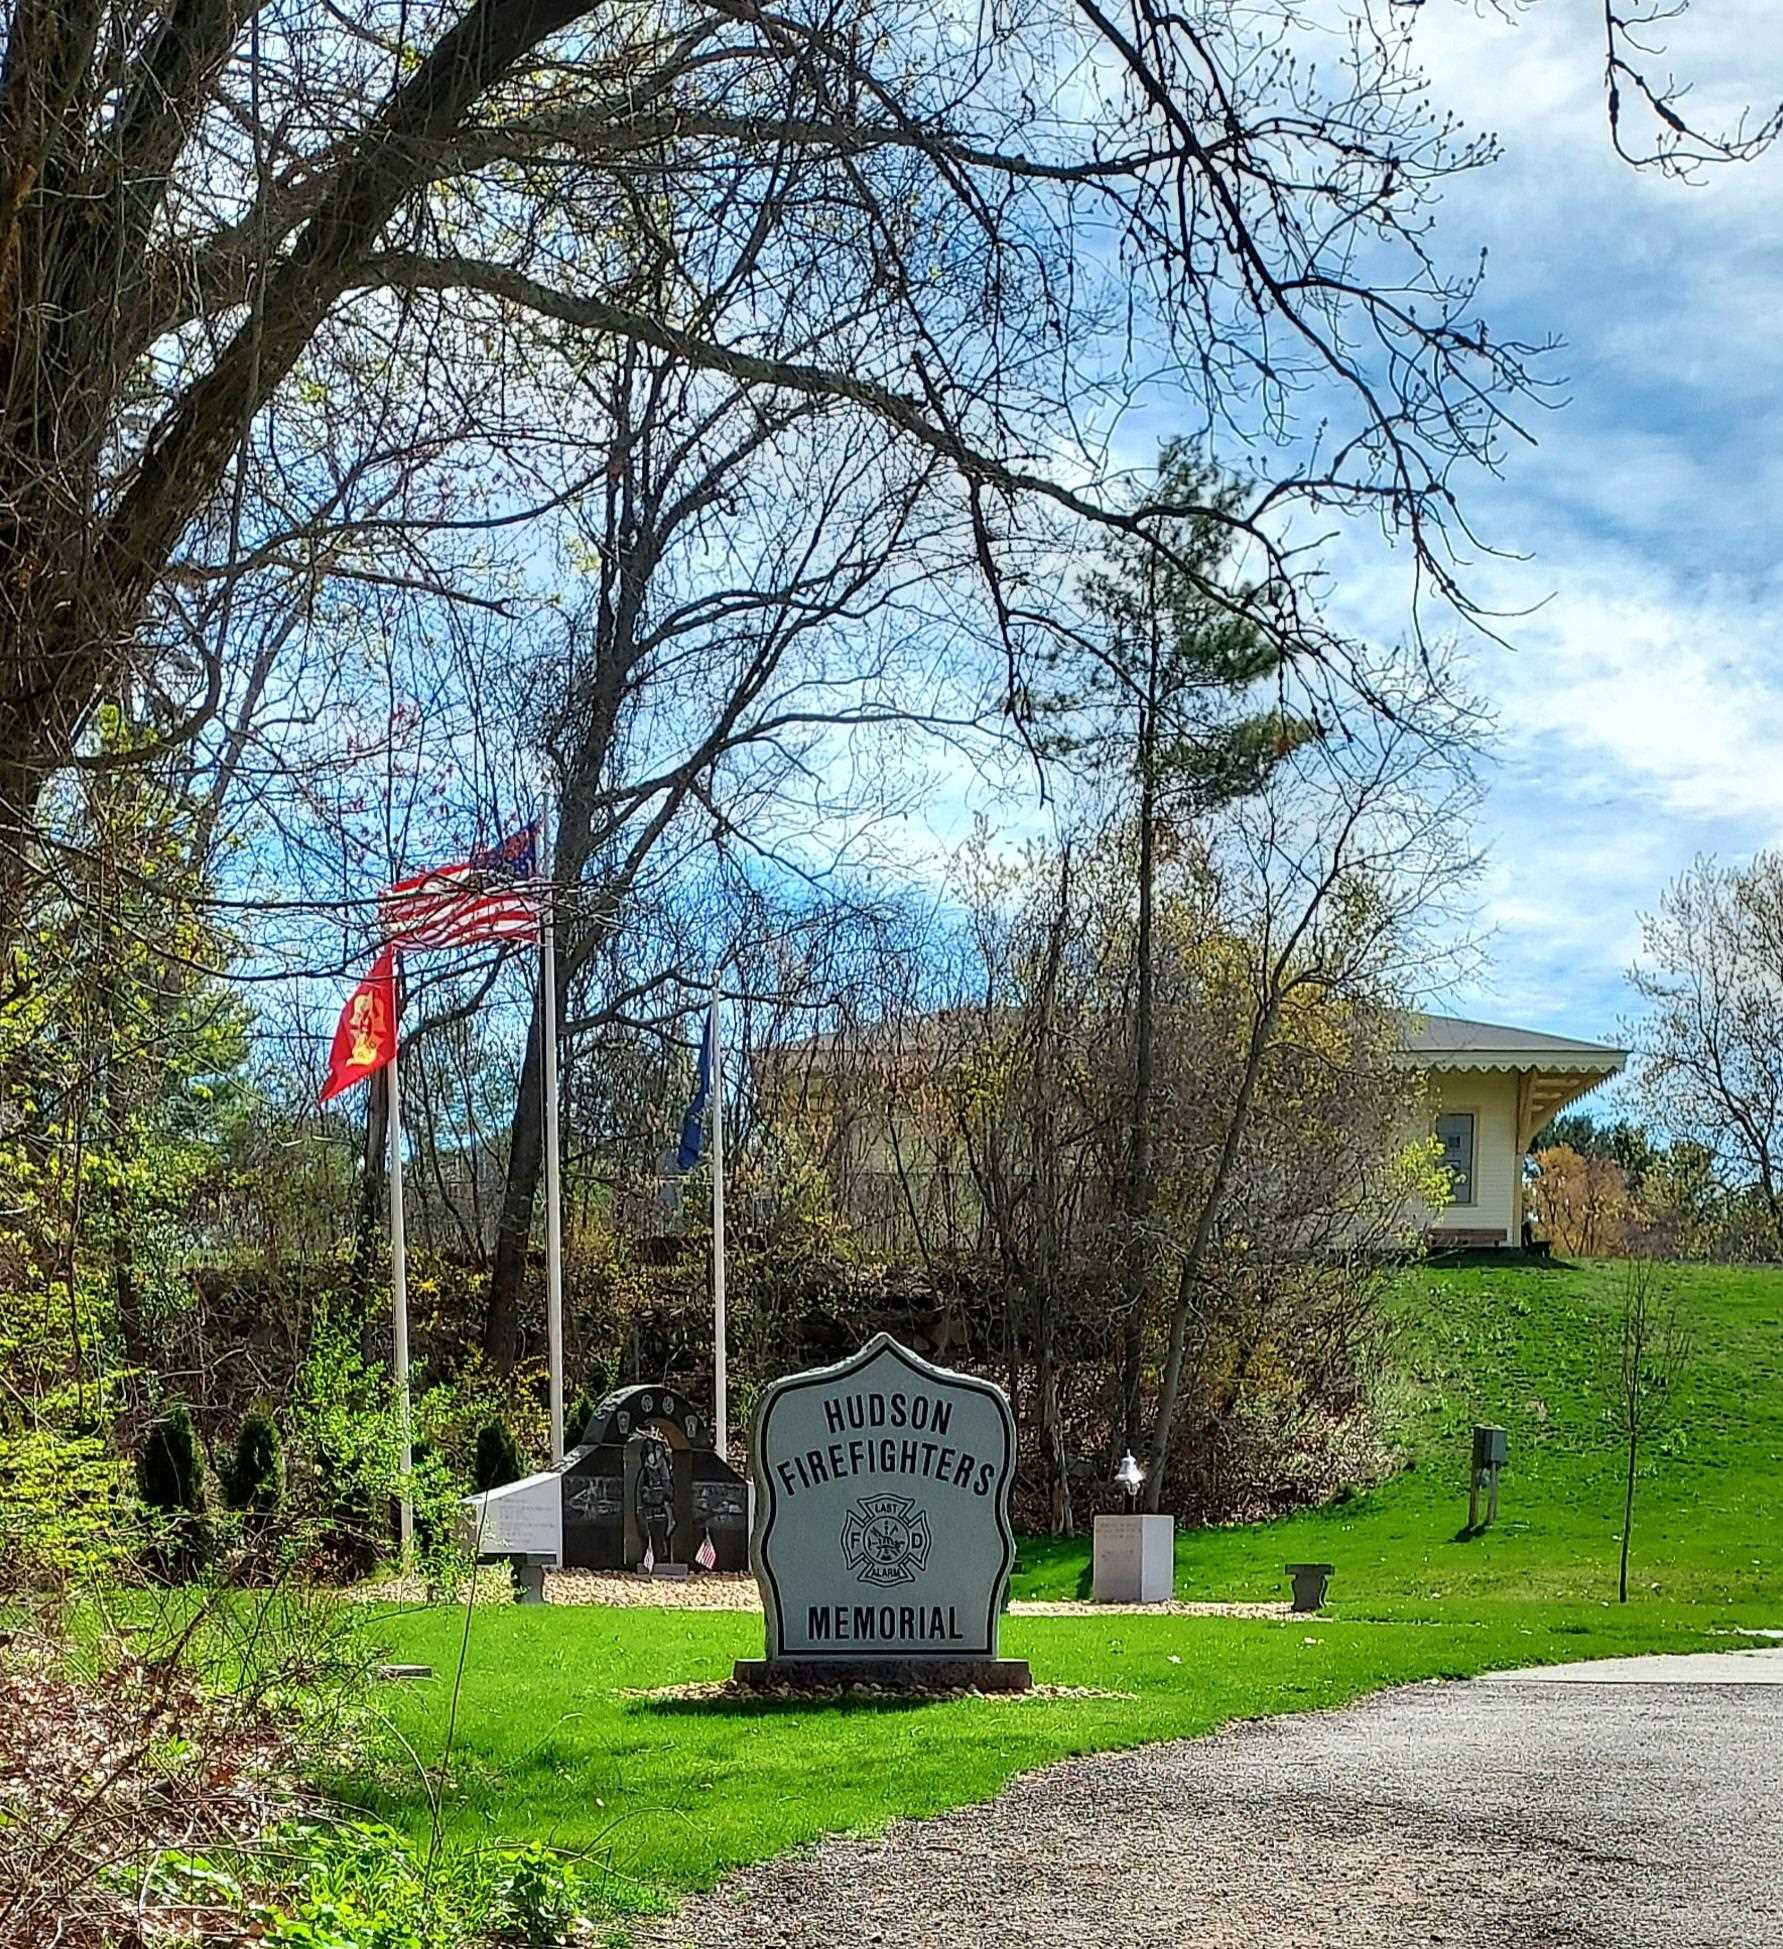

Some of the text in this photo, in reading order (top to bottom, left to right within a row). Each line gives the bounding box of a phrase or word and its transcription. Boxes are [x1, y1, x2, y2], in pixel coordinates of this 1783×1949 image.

[823, 1393, 953, 1435] HUDSON
[776, 1439, 996, 1497] FIREFIGHTERS
[874, 1503, 898, 1513] LAST
[851, 1532, 923, 1549] F D
[871, 1567, 901, 1578] ALARM
[808, 1606, 963, 1640] MEMORIAL
